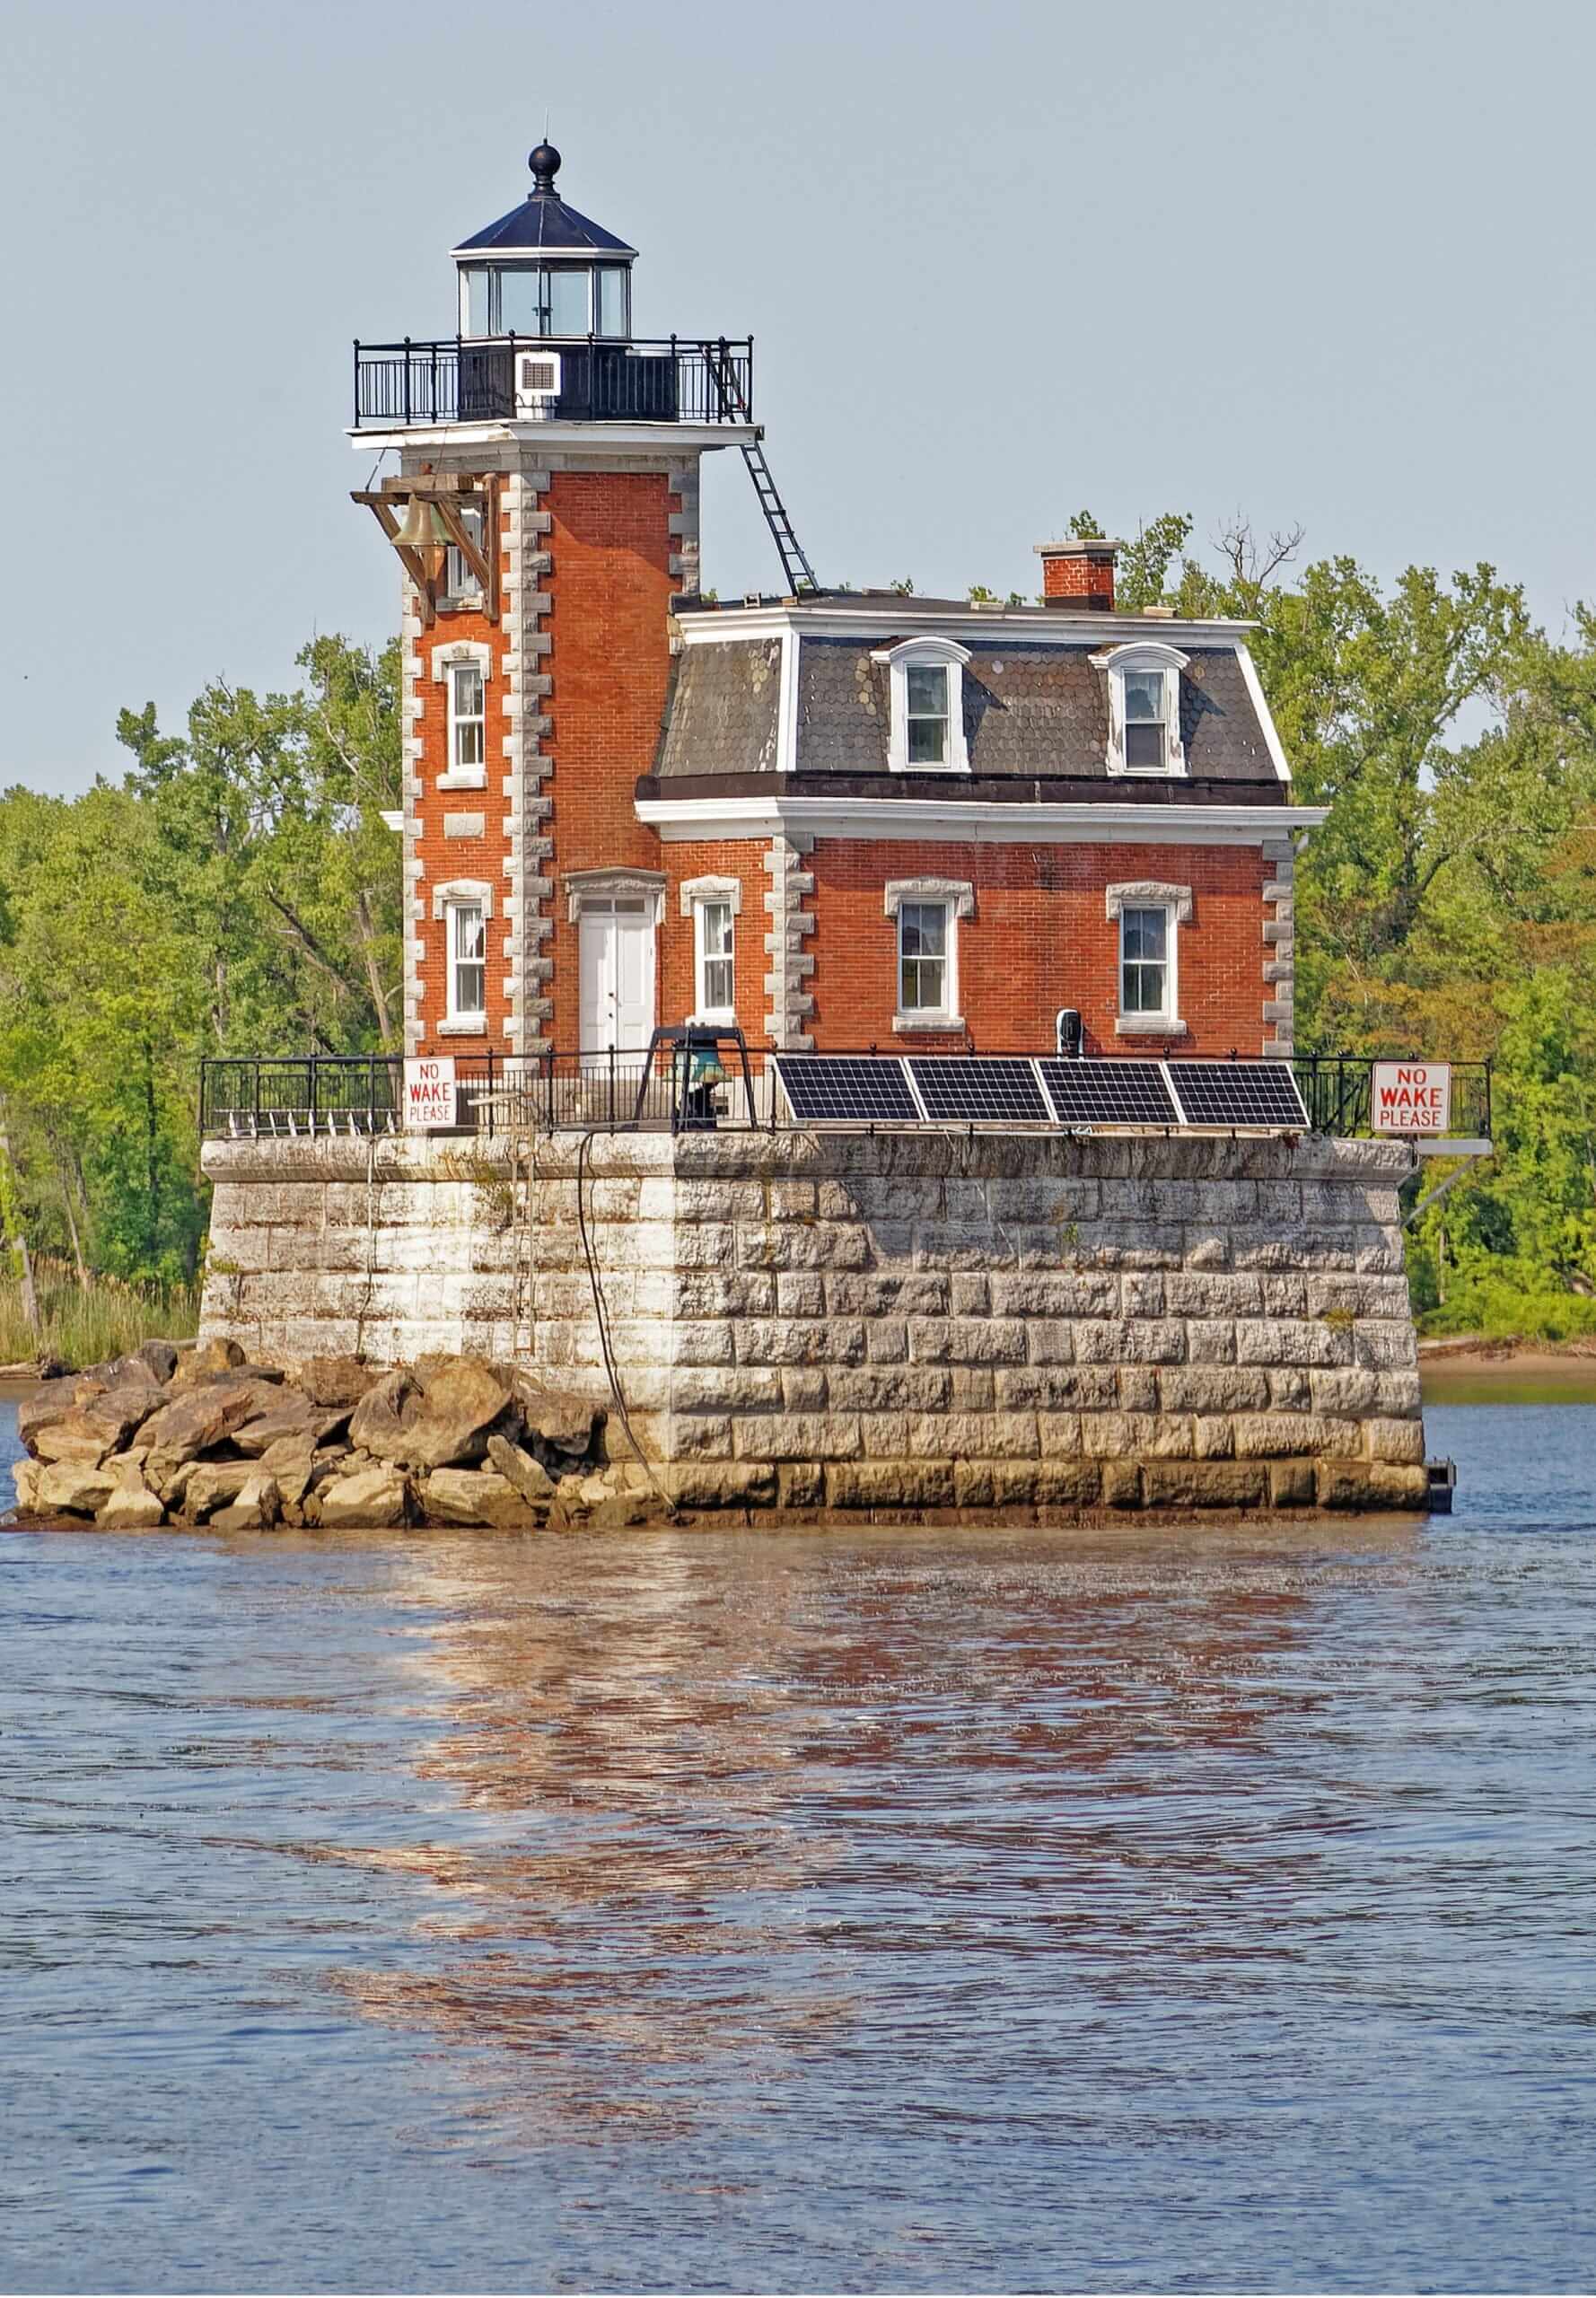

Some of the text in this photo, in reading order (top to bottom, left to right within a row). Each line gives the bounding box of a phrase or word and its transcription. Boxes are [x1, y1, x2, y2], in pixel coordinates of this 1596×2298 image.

[420, 1064, 439, 1079] NO
[1398, 1068, 1426, 1084] NO
[410, 1083, 451, 1102] WAKE
[1381, 1088, 1443, 1108] WAKE
[410, 1105, 450, 1121] PLEASE
[1381, 1110, 1441, 1127] PLEASE
